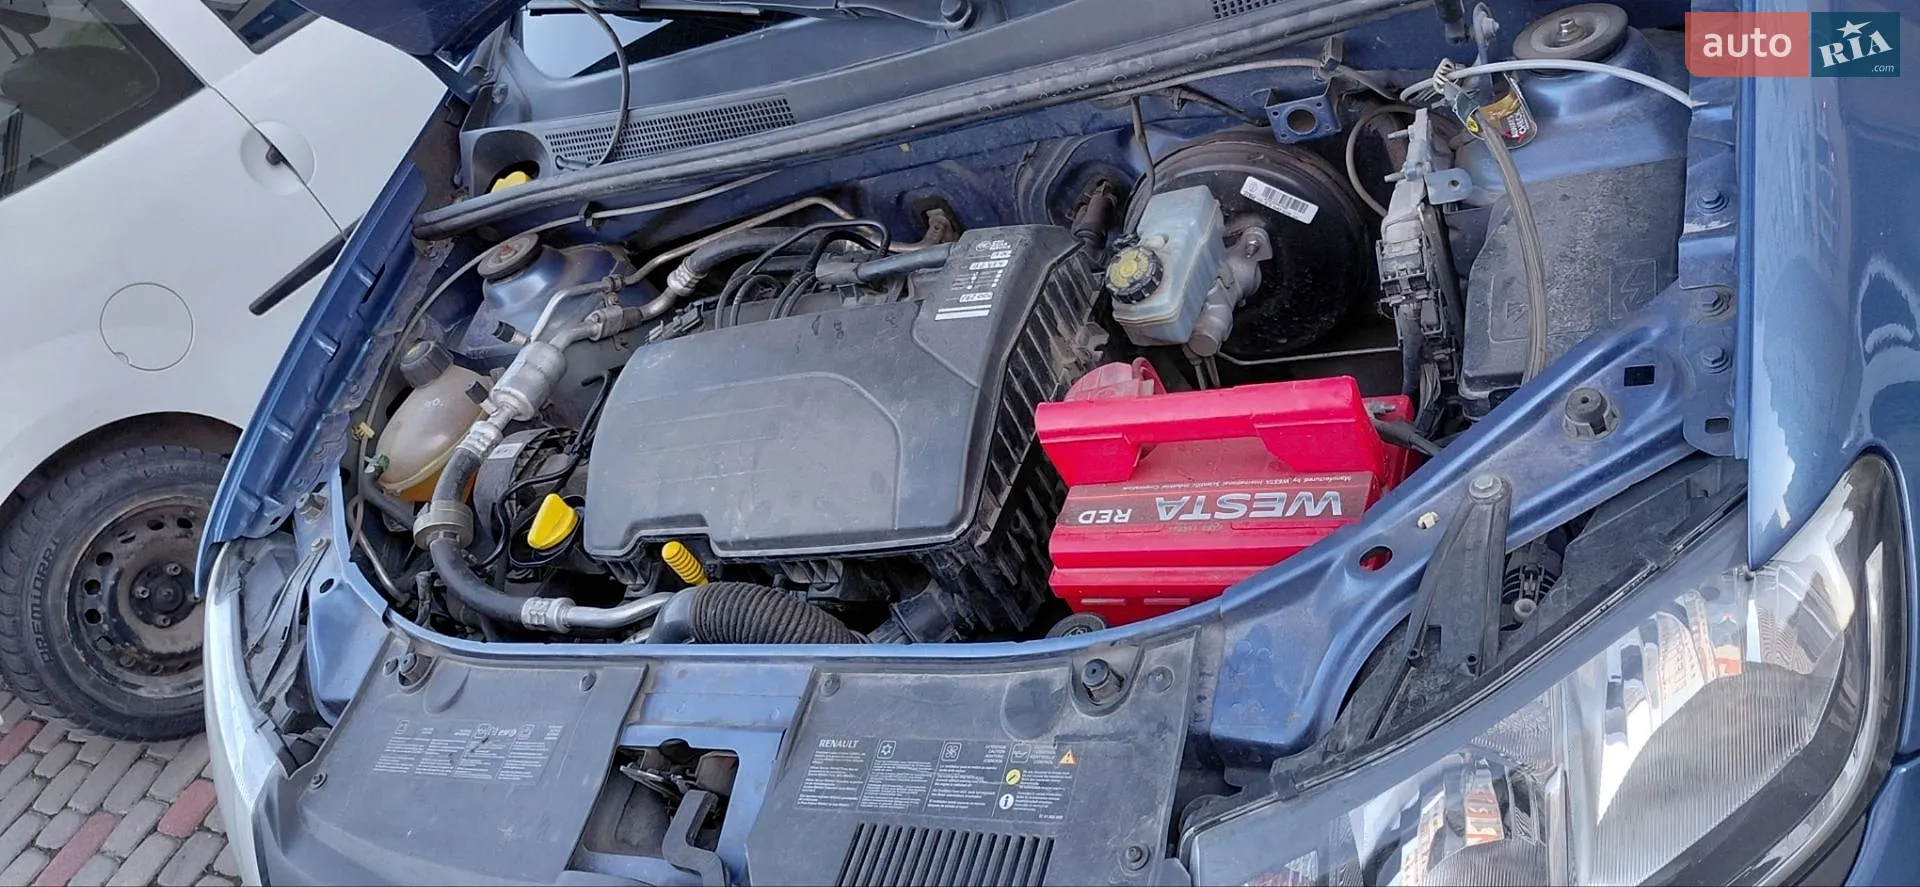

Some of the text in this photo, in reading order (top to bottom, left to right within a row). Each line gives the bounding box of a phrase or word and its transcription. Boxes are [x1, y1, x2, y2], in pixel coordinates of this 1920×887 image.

[1156, 491, 1342, 521] WESTA
[1078, 508, 1131, 524] RED
[818, 739, 859, 748] RENAULT
